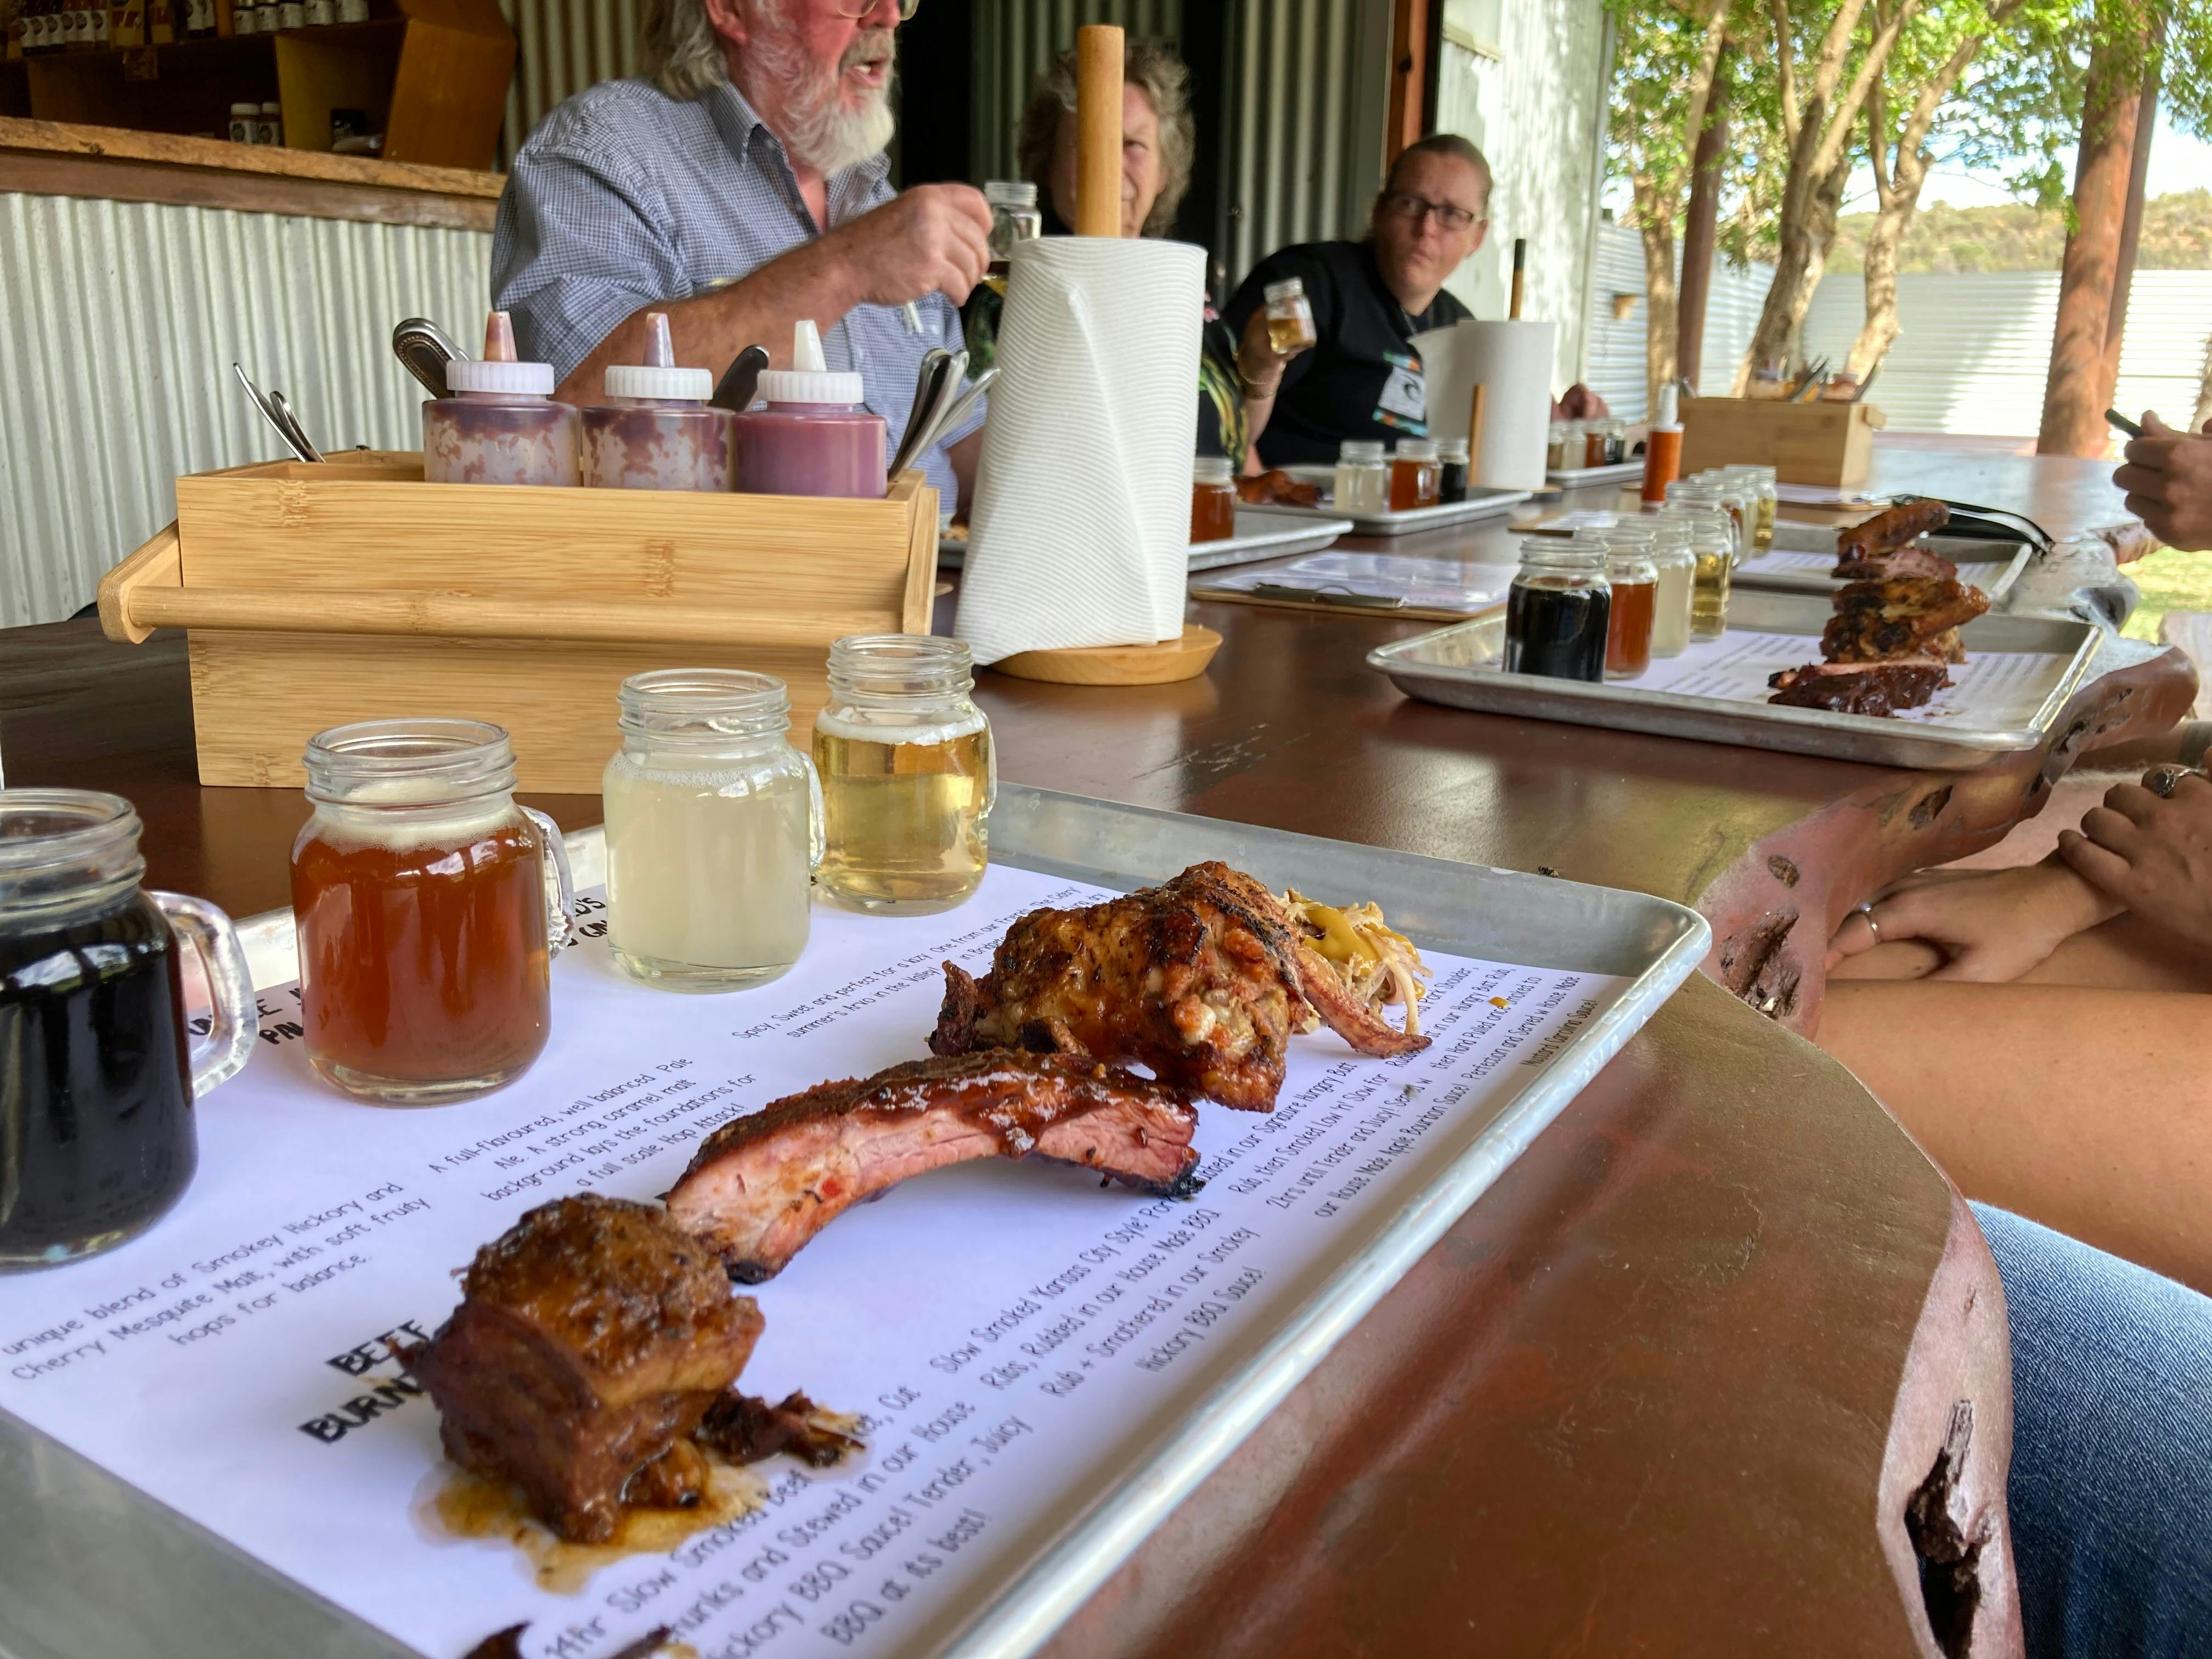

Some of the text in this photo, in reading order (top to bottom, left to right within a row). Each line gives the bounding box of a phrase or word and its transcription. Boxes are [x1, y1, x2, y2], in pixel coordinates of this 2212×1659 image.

[930, 943, 957, 953] One
[951, 931, 984, 944] from
[980, 923, 999, 932] our
[732, 1022, 781, 1039] Spicy,
[771, 1004, 814, 1021] Sweet
[812, 993, 838, 1006] and
[835, 975, 879, 996] perfect
[875, 966, 899, 978] for
[902, 953, 933, 966] lazy
[787, 1010, 848, 1038] summer's
[843, 997, 876, 1012] Arvo
[869, 990, 890, 998] in
[885, 981, 910, 992] the
[1417, 990, 1447, 1004] Pork
[1449, 992, 1489, 1011] Hungry
[1472, 980, 1499, 992] Butt
[1535, 992, 1567, 1008] House
[1552, 976, 1581, 991] Made
[1430, 1054, 1459, 1070] then
[1445, 1038, 1477, 1054] Hand
[1462, 1020, 1496, 1039] Pulled
[1442, 1012, 1462, 1023] our
[1502, 1036, 1523, 1048] and
[1508, 1014, 1544, 1035] Served
[1544, 1019, 1582, 1043] Carolina
[1461, 1047, 1510, 1080] Perfection
[428, 1164, 448, 1173] A
[559, 1100, 594, 1116] well
[588, 1074, 656, 1102] balanced
[656, 1058, 693, 1073] Pale
[480, 1074, 756, 1201] background lays the foundations for
[527, 1146, 546, 1154] A
[545, 1120, 607, 1147] strong
[603, 1093, 663, 1121] caramel
[661, 1079, 697, 1095] malt
[1221, 1147, 1246, 1158] in
[1239, 1133, 1262, 1148] our
[1252, 1101, 1307, 1133] Signature
[1327, 1062, 1357, 1076] Butt
[1254, 1156, 1289, 1176] then
[1276, 1126, 1326, 1156] Smoked
[1311, 1112, 1344, 1128] Low
[1342, 1085, 1376, 1102] Slow
[1363, 1074, 1390, 1085] for
[577, 1177, 593, 1187] a
[588, 1162, 623, 1180] full
[621, 1144, 663, 1164] scale
[658, 1128, 698, 1145] Hop
[1296, 1166, 1328, 1186] until
[1312, 1142, 1356, 1167] Tender
[1350, 1126, 1375, 1142] and
[1314, 1200, 1340, 1217] our
[1327, 1176, 1370, 1200] House
[1355, 1156, 1392, 1176] Made
[1378, 1136, 1415, 1157] Apple
[1400, 1105, 1448, 1136] Bourbon
[2, 1182, 403, 1355] unique blend of Smokey Hickory and
[12, 1340, 106, 1380] Cherry
[108, 1294, 213, 1341] Mesquite
[274, 1245, 324, 1268] with
[325, 1222, 371, 1245] soft
[370, 1198, 431, 1224] fruity
[1019, 1314, 1086, 1359] Rubbed
[1071, 1303, 1103, 1318] in
[1096, 1283, 1125, 1304] our
[1115, 1252, 1166, 1283] House
[1152, 1229, 1196, 1254] Made
[1181, 1208, 1222, 1229] BBQ
[168, 1314, 236, 1345] hops
[237, 1292, 277, 1314] for
[930, 1341, 982, 1374] Slow
[970, 1297, 1042, 1343] Smoked
[1079, 1244, 1121, 1263] City
[1040, 1370, 1085, 1398] Rub
[1086, 1295, 1173, 1357] Smothered
[1156, 1284, 1188, 1298] in
[1181, 1265, 1209, 1284] our
[1197, 1226, 1261, 1263] Smokey
[1135, 1327, 1205, 1372] Hickory
[1184, 1301, 1229, 1327] BBQ
[606, 1569, 678, 1614] Slow
[878, 1385, 922, 1410] Cut
[741, 1544, 789, 1583] and
[777, 1487, 862, 1547] Stewed
[850, 1472, 886, 1494] in
[882, 1442, 918, 1473] our
[910, 1401, 976, 1443] House
[789, 1560, 852, 1603] BBQ
[821, 1599, 887, 1646] BBQ
[881, 1576, 911, 1602] at
